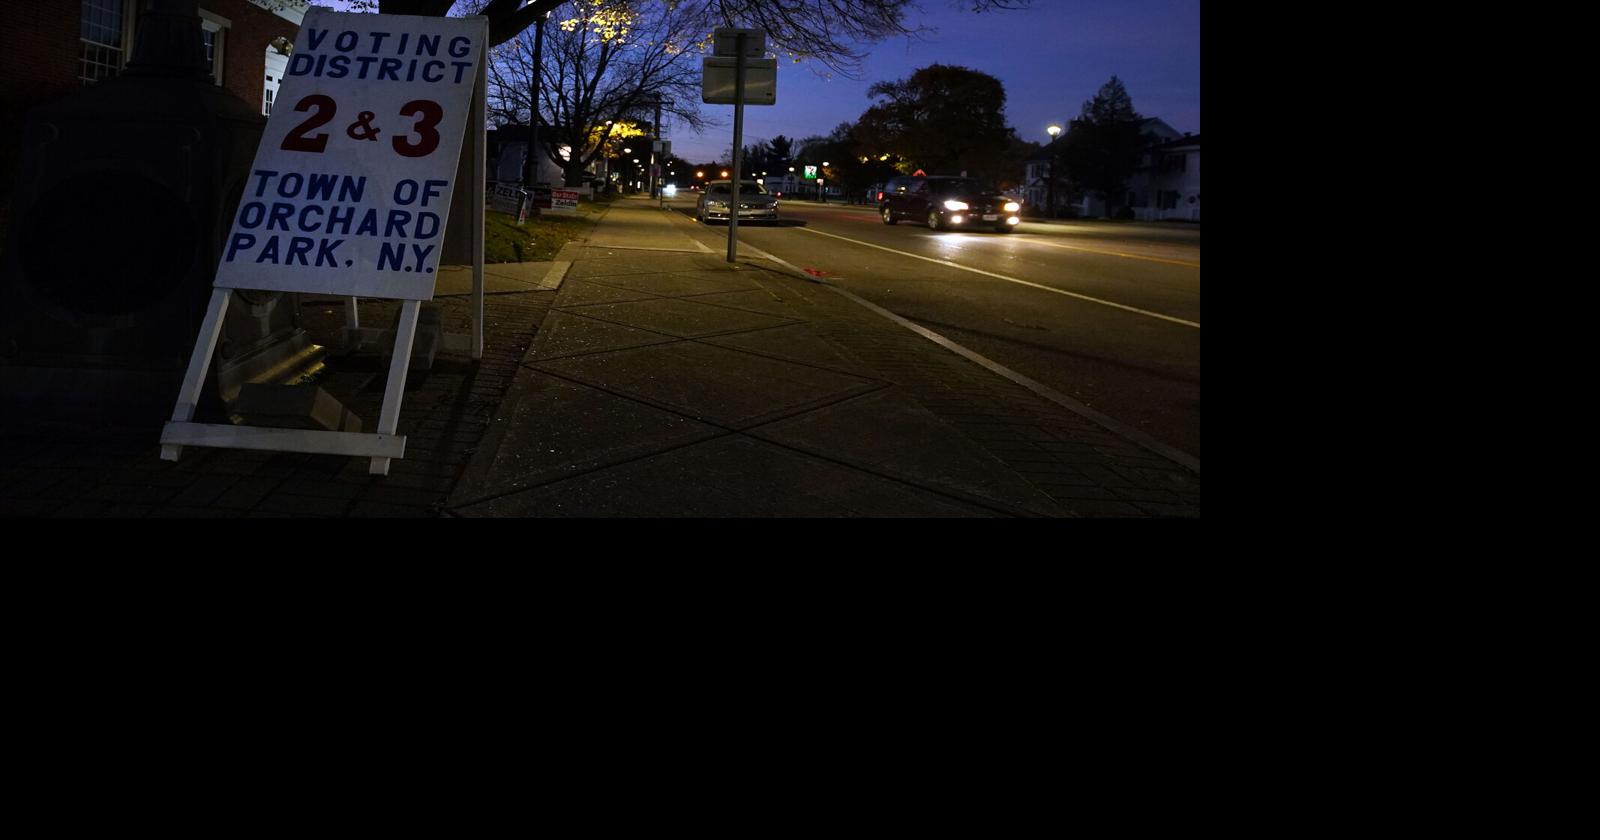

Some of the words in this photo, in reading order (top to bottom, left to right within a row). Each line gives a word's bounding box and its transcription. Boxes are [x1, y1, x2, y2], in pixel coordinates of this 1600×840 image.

[308, 29, 470, 57] VOTING
[289, 54, 472, 83] DISTRICT
[281, 94, 336, 153] 2
[347, 110, 380, 141] &
[392, 100, 443, 157] 3
[254, 170, 366, 202] TOWN
[393, 179, 448, 206] OF
[239, 202, 440, 239] ORCHARD
[377, 243, 434, 273] N.Y.
